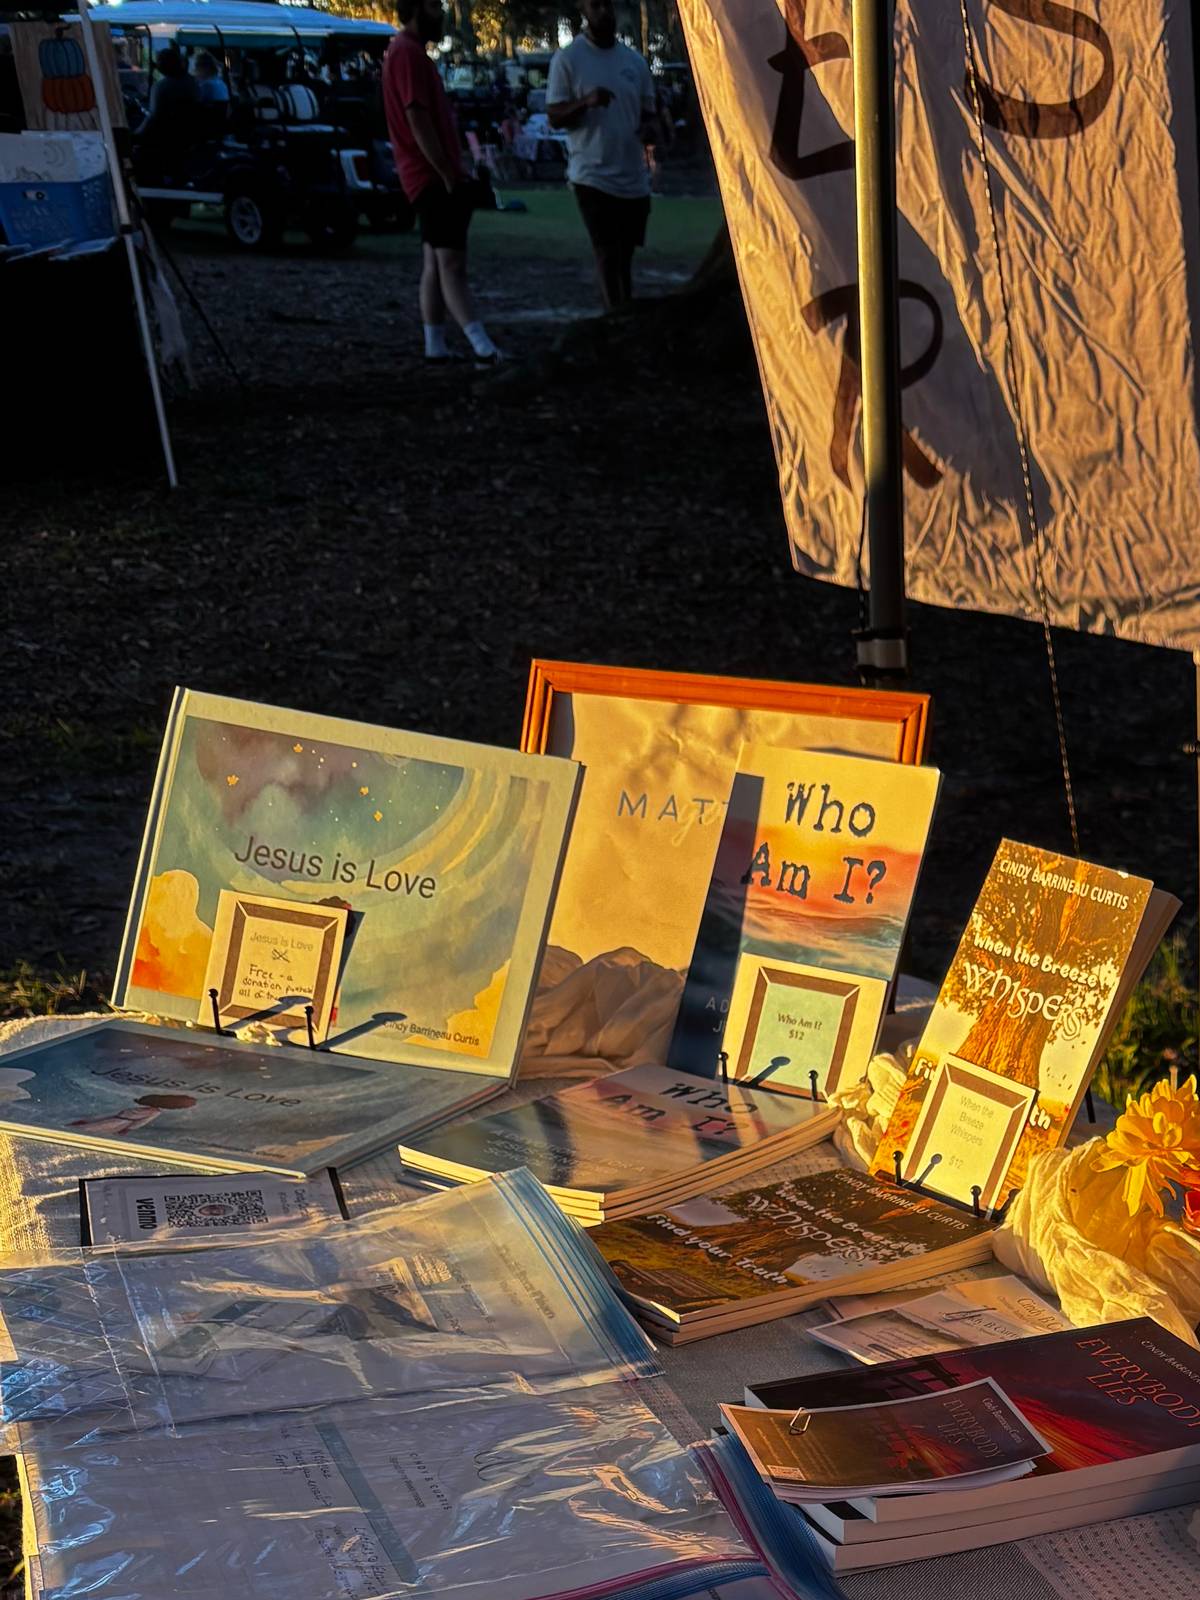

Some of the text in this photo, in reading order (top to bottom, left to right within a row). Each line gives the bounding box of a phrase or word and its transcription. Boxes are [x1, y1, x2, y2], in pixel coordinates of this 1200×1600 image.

[786, 782, 876, 838] Who
[234, 835, 436, 900] Jesus is Love
[741, 842, 888, 905] Am I?
[1000, 859, 1130, 910] CINDY BARRINEAU CURTIS
[250, 932, 277, 945] Jesus
[291, 938, 313, 951] Love
[973, 929, 1098, 988] When the Breeze
[778, 1012, 823, 1031] Who Am I?
[963, 961, 1084, 1041] Whispers
[410, 1023, 452, 1041] Barrineau
[453, 1032, 480, 1046] Curtis
[788, 1028, 805, 1041] $12
[91, 1065, 302, 1109] Jesus is Love
[661, 1080, 757, 1115] Who
[601, 1094, 750, 1137] Am I?
[136, 1197, 158, 1230] venmo
[775, 1187, 902, 1254] When the Breeze
[835, 1172, 968, 1232] CINDY BARRINEAU CURTIS
[646, 1212, 789, 1287] Find your Truth
[1087, 1372, 1149, 1406] LIES
